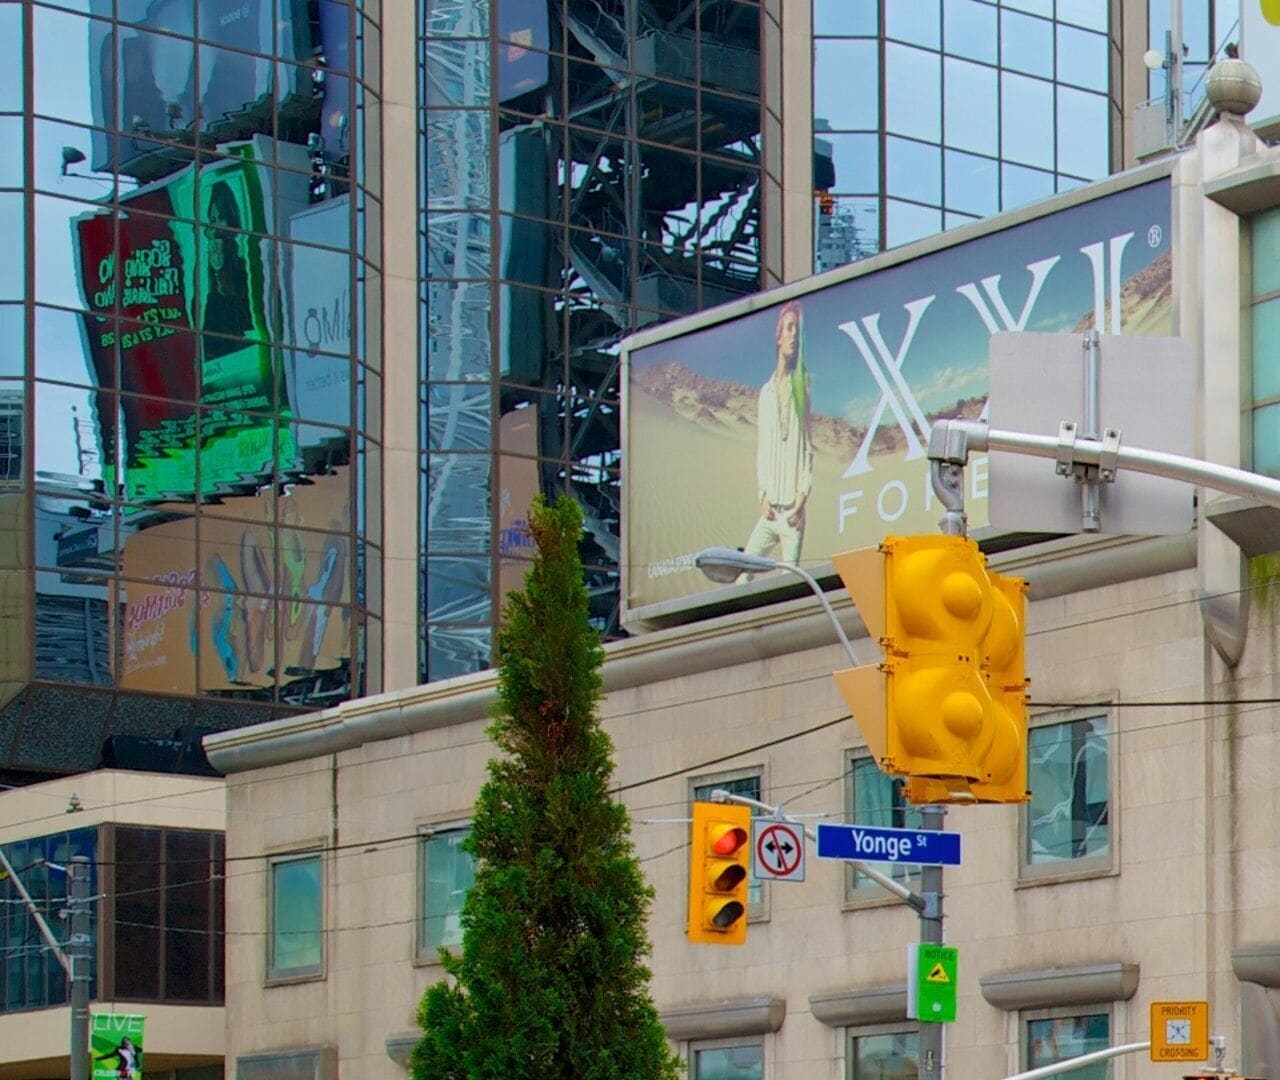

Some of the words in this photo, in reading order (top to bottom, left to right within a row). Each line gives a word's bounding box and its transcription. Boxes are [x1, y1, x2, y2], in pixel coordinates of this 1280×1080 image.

[852, 830, 912, 861] Yonge
[916, 834, 928, 847] St
[1160, 1006, 1197, 1017] PRIORITY
[92, 1014, 143, 1033] LIVE
[1159, 1048, 1199, 1058] CROSSING
